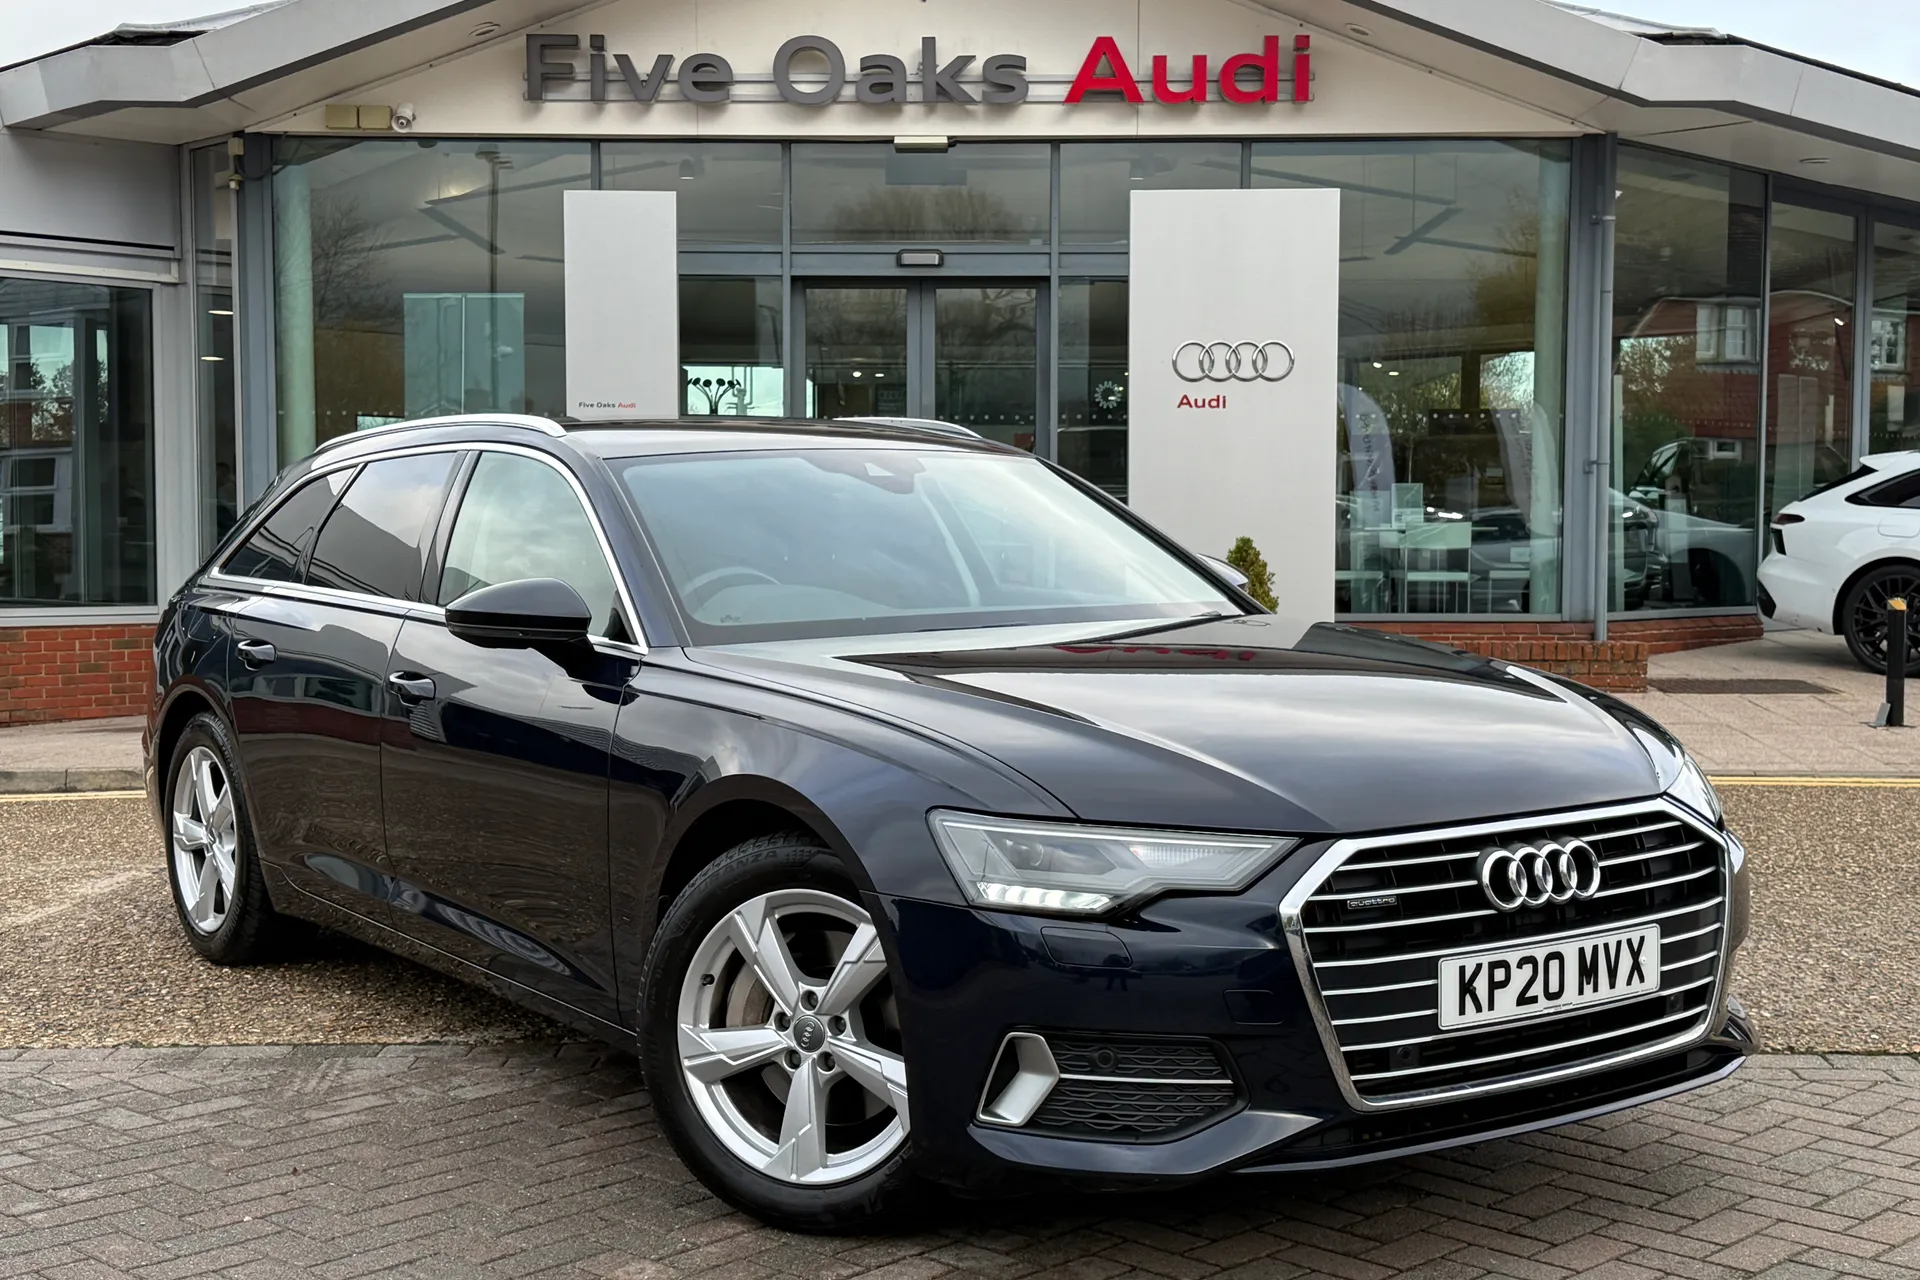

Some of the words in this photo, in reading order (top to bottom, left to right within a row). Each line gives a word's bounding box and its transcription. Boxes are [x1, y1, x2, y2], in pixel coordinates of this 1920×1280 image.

[525, 34, 733, 103] Five
[773, 35, 1029, 105] Oaks
[1064, 34, 1311, 104] Audi
[1177, 394, 1226, 409] Audi
[694, 850, 779, 896] URANZA
[1350, 897, 1395, 907] quattro
[1458, 950, 1565, 1016] KP20
[1578, 935, 1646, 996] MVX
